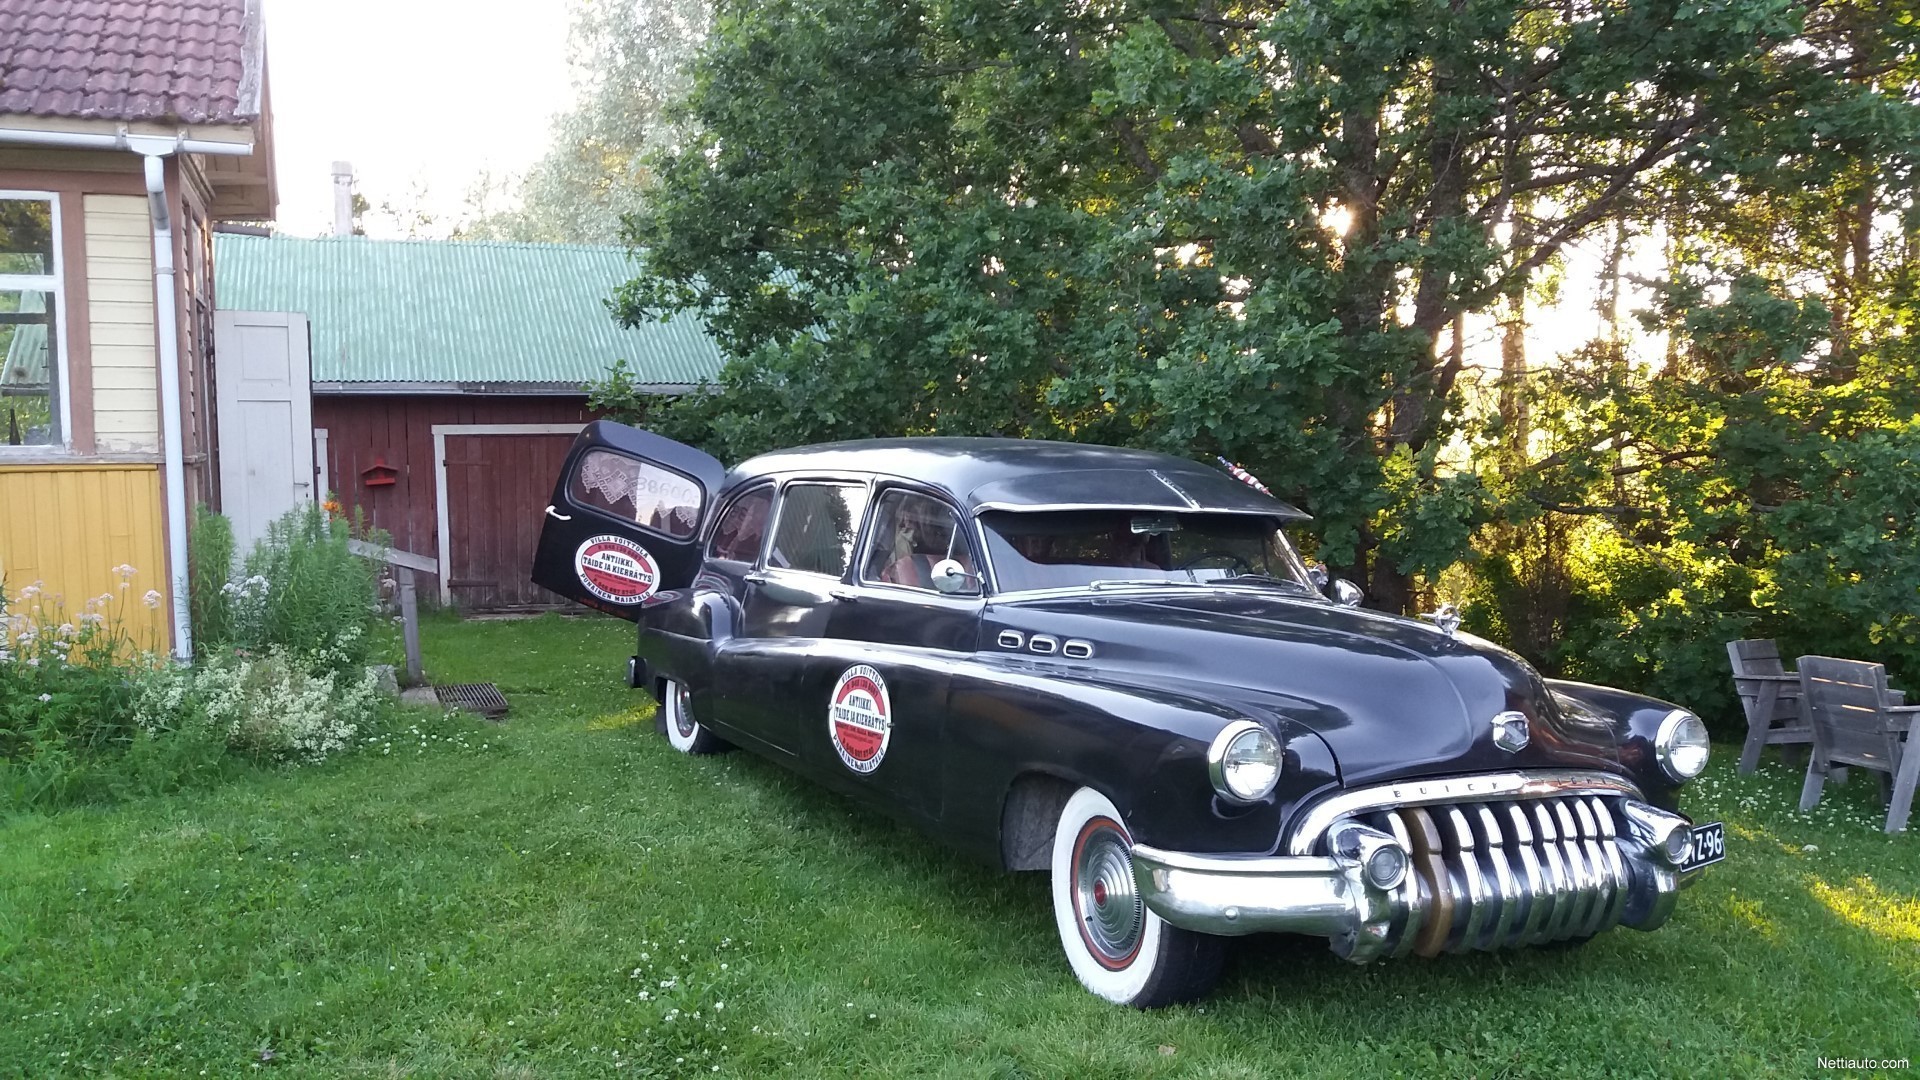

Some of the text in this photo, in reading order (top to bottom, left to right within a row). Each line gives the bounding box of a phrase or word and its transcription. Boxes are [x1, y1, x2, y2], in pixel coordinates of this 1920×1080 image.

[590, 536, 649, 559] VILLA VOITTOLA
[583, 556, 604, 569] TAIDE
[612, 565, 652, 583] KIERRÄTYS
[580, 573, 612, 600] PUNAINEN
[841, 667, 858, 684] VILLA
[859, 666, 884, 692] VOITTOLA
[835, 706, 850, 721] TAIDE
[1393, 782, 1499, 799] BUICK
